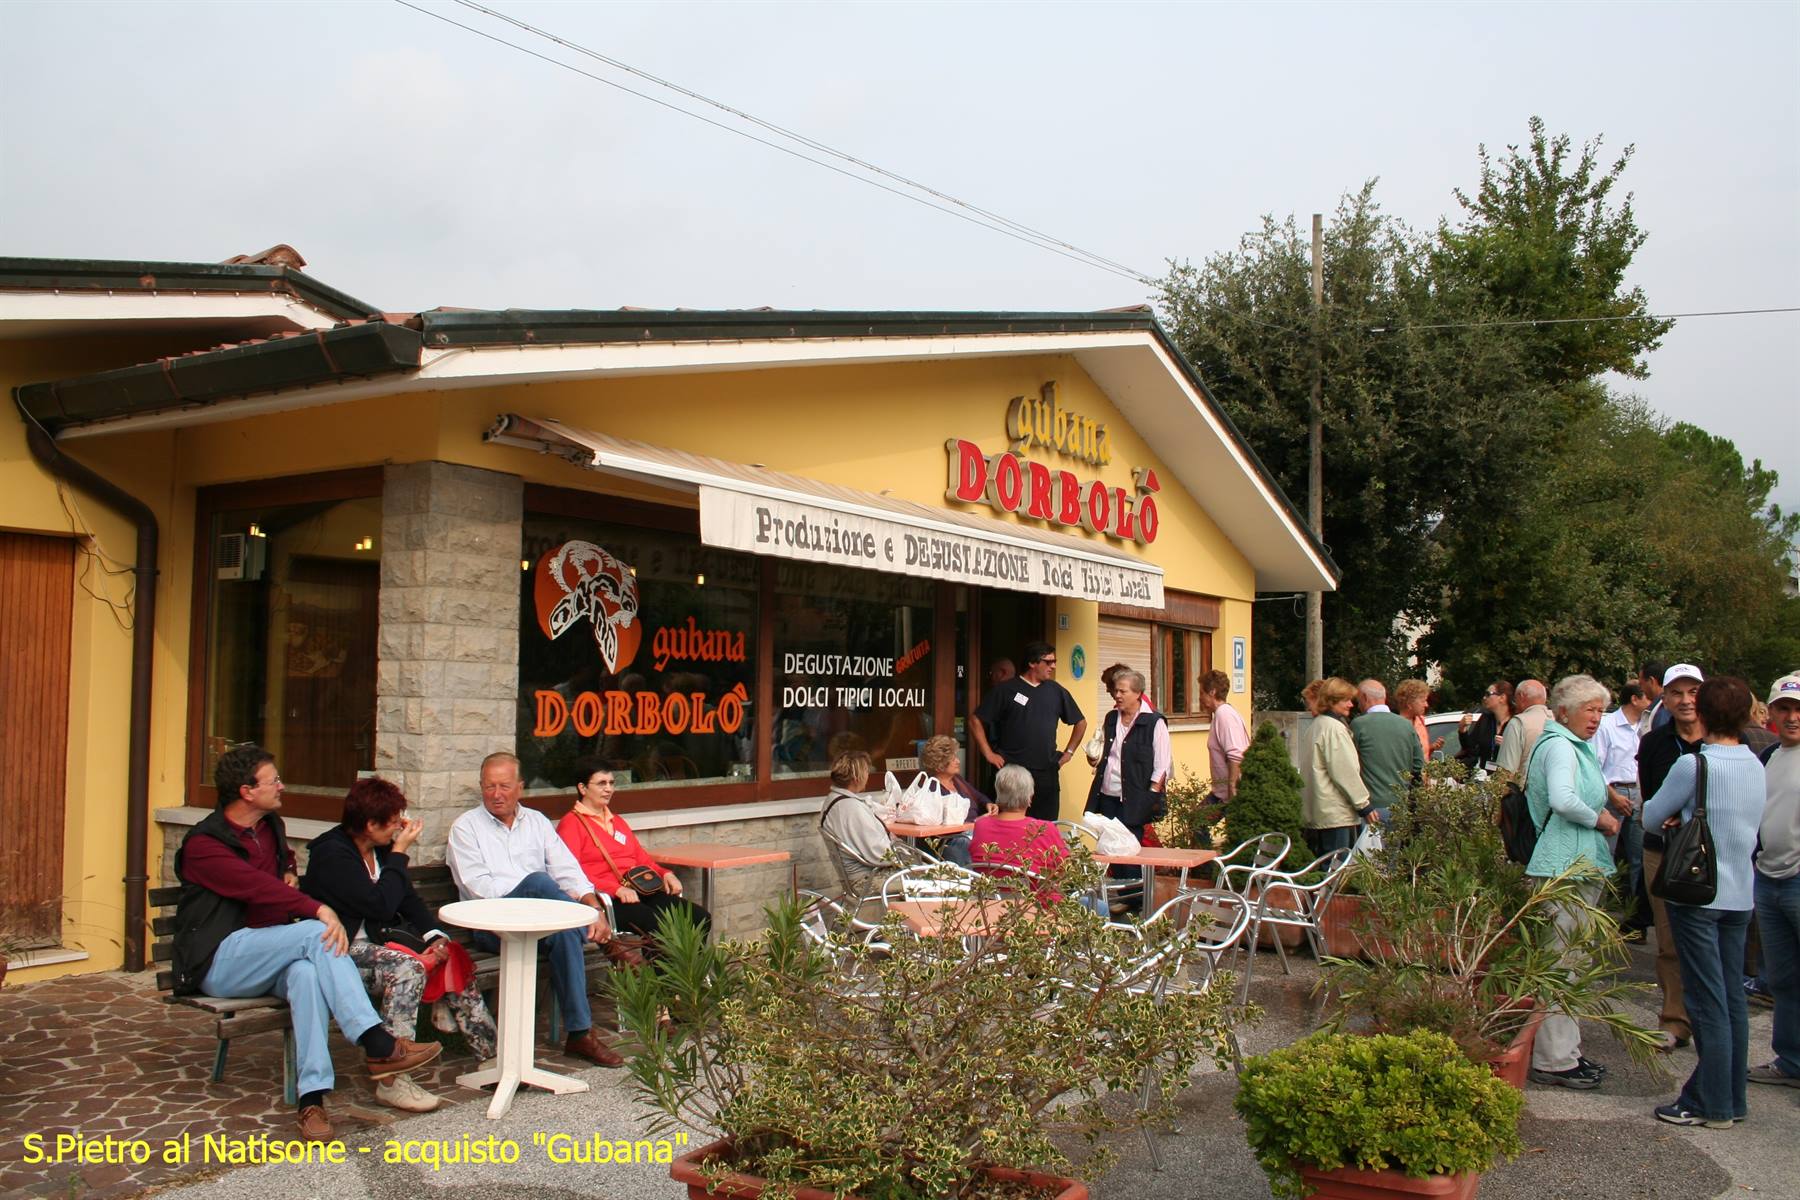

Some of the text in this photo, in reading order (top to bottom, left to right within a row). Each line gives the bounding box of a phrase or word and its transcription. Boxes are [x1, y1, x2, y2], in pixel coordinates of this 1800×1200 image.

[1007, 380, 1113, 466] gubana
[756, 507, 876, 559] Produzione
[884, 536, 894, 562] e
[904, 533, 1030, 583] DEGUSTAZIONE
[1081, 567, 1114, 596] Tipc
[653, 616, 747, 672] gubana
[784, 653, 894, 677] DEGUSTAZIONE
[783, 686, 925, 708] DOLCI TIPICI LOCALI
